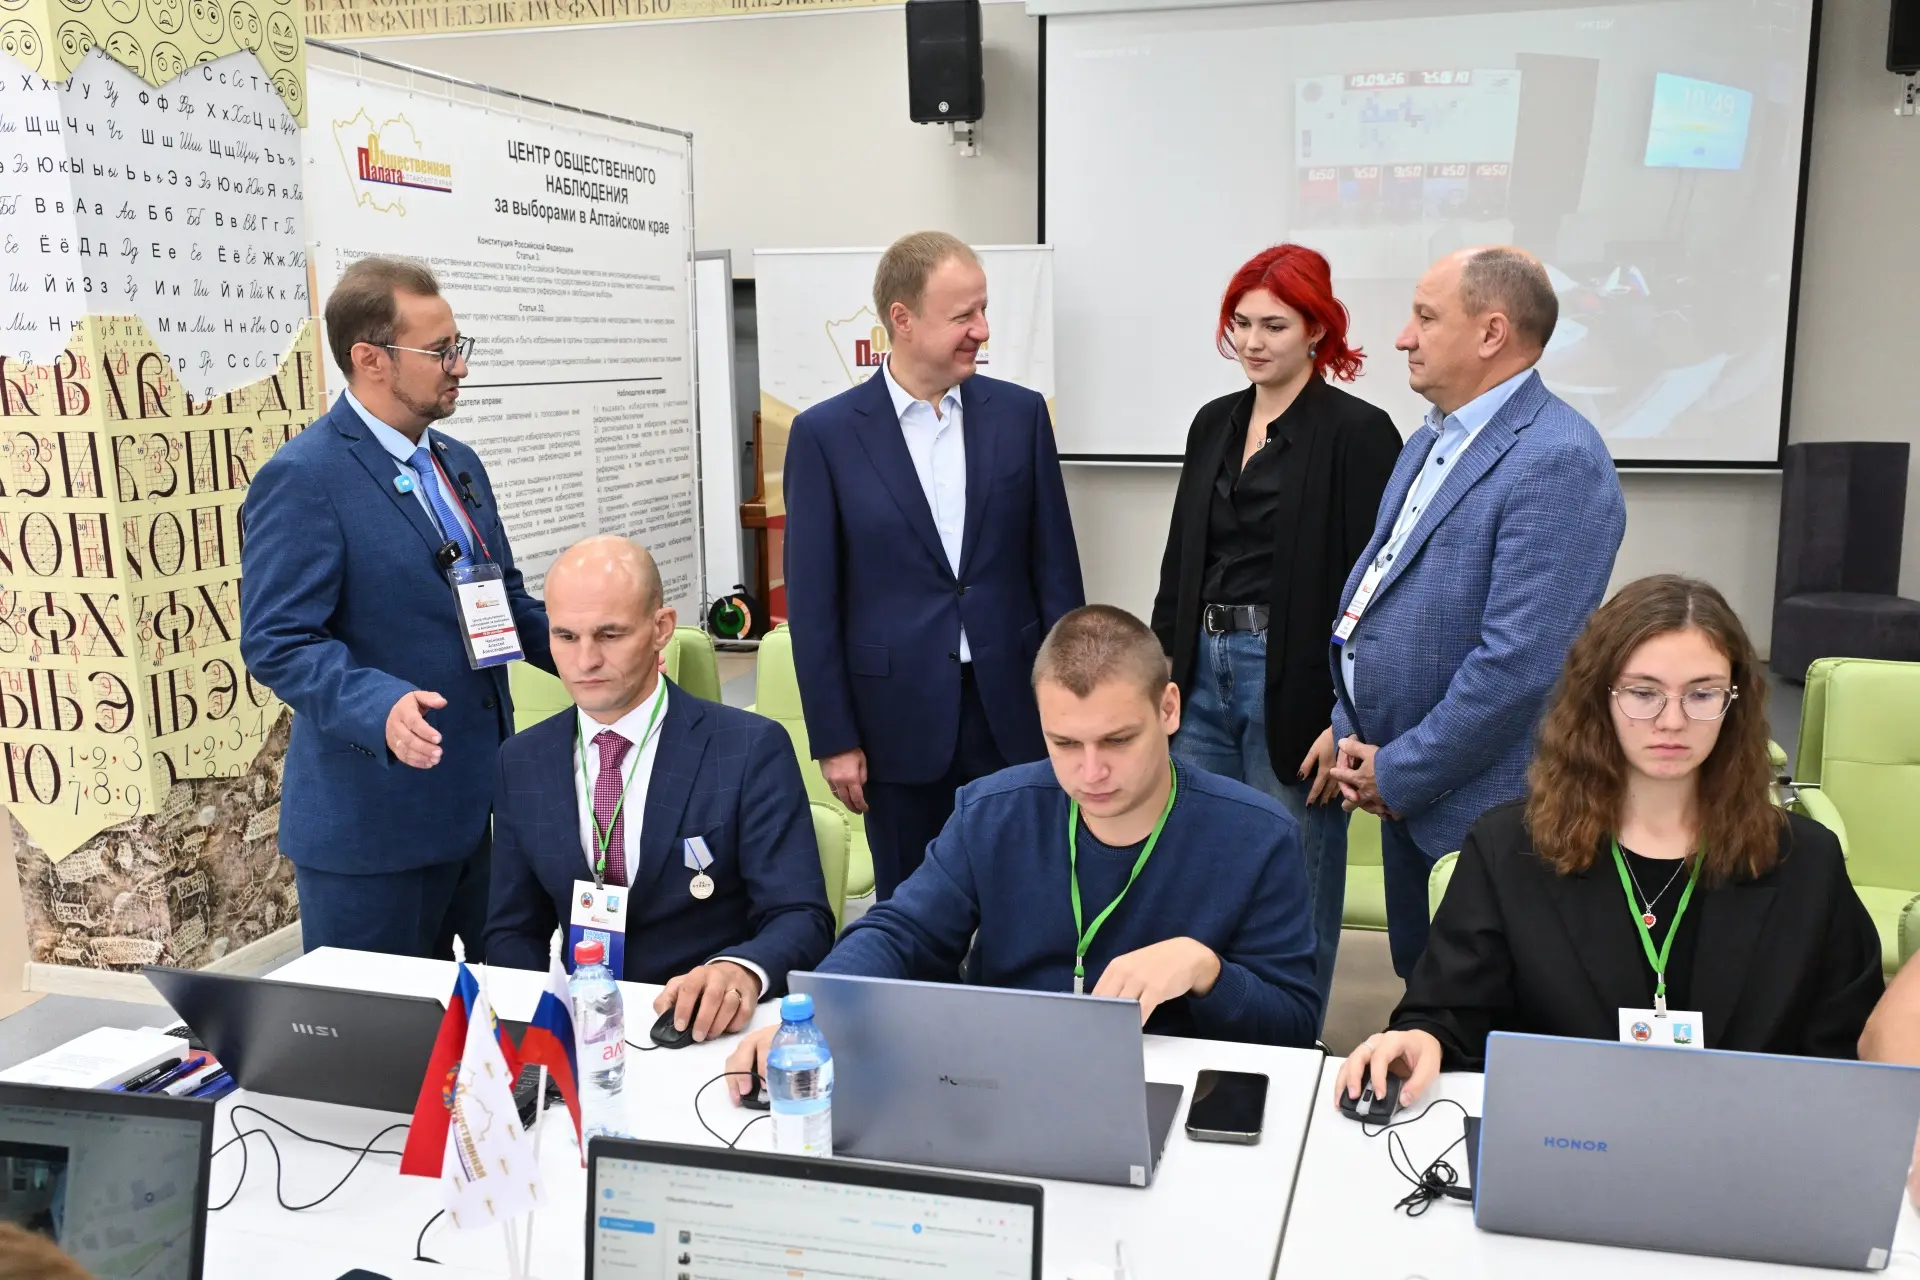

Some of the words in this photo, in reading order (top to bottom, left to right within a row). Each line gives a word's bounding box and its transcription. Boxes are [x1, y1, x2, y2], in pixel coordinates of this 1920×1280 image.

[357, 147, 403, 184] Палата
[368, 133, 452, 178] Общественная
[508, 140, 550, 165] ЦЕНТР
[554, 150, 656, 185] ОБЩЕСТВЕННОГО
[546, 174, 629, 205] НАБЛЮДЕНИЯ
[494, 198, 508, 213] за
[513, 199, 576, 224] выборами
[580, 211, 586, 224] в
[590, 208, 646, 232] Алтайском
[649, 220, 670, 236] крае
[477, 236, 513, 248] Конституция
[514, 240, 545, 251] Российской
[516, 251, 534, 261] Статья
[518, 303, 537, 312] Статья
[291, 1022, 338, 1038] MSI
[1543, 1136, 1608, 1153] HONOR
